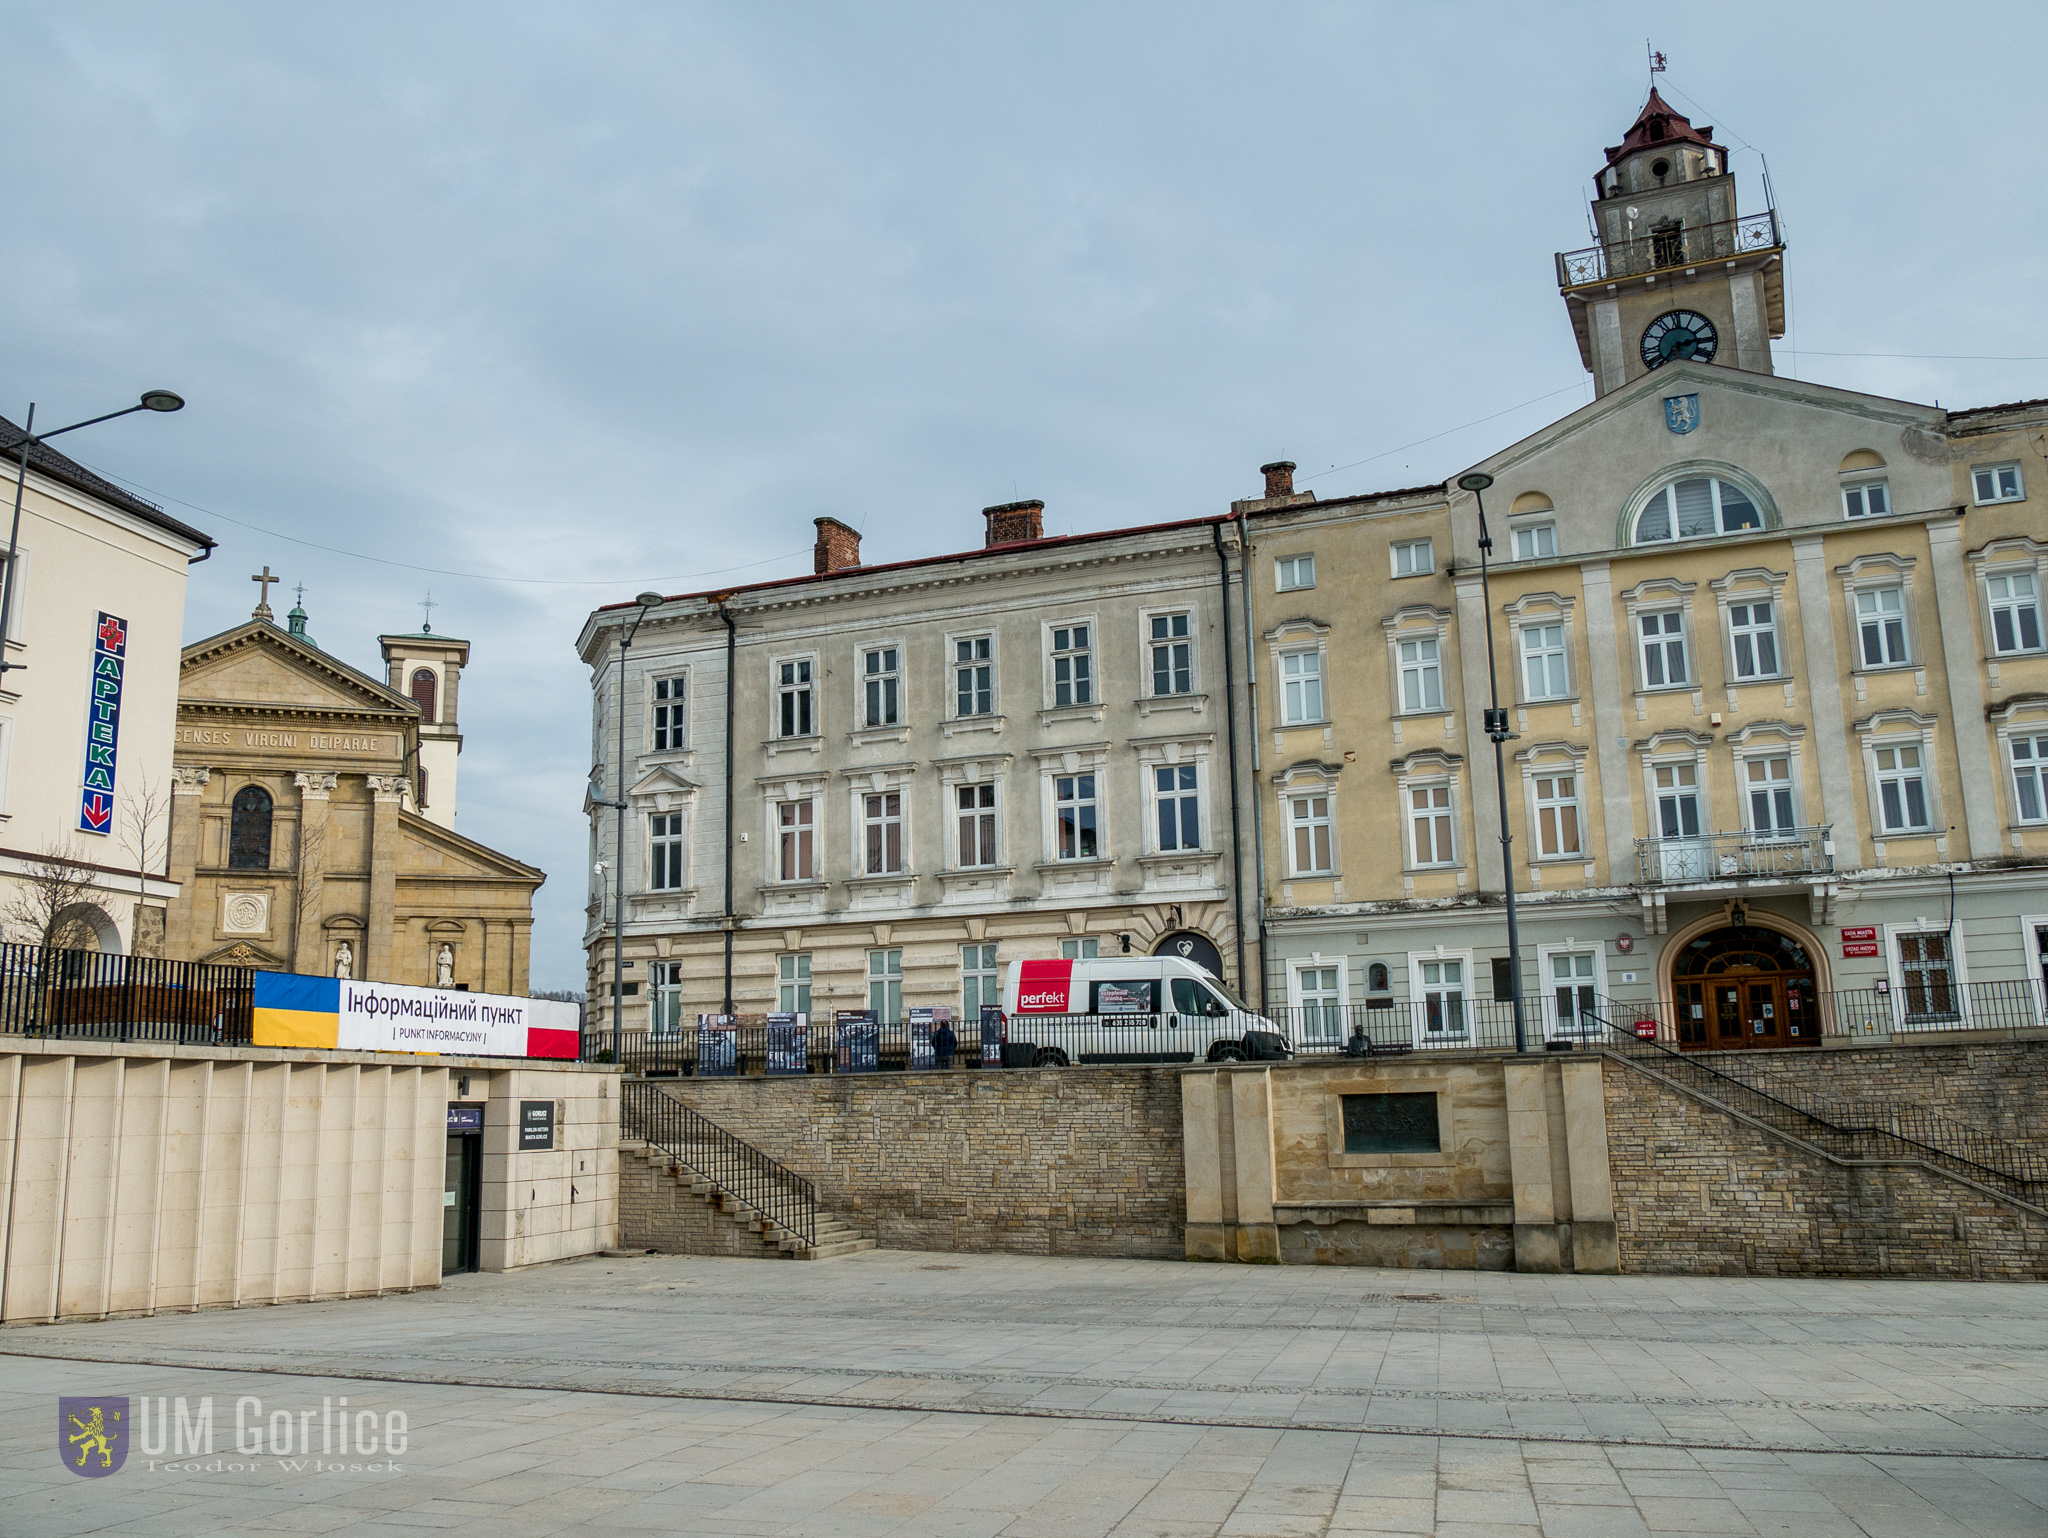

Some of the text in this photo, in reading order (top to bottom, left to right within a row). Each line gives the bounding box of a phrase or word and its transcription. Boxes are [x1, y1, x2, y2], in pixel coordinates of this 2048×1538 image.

[86, 656, 121, 790] APTEKA
[246, 733, 297, 748] VIRGINI
[310, 736, 378, 751] DEIPARAE
[348, 987, 523, 1028] Інформаційний пункт
[1020, 991, 1065, 1006] perfekt
[399, 1027, 483, 1043] PUNKT INFORMACYJNY
